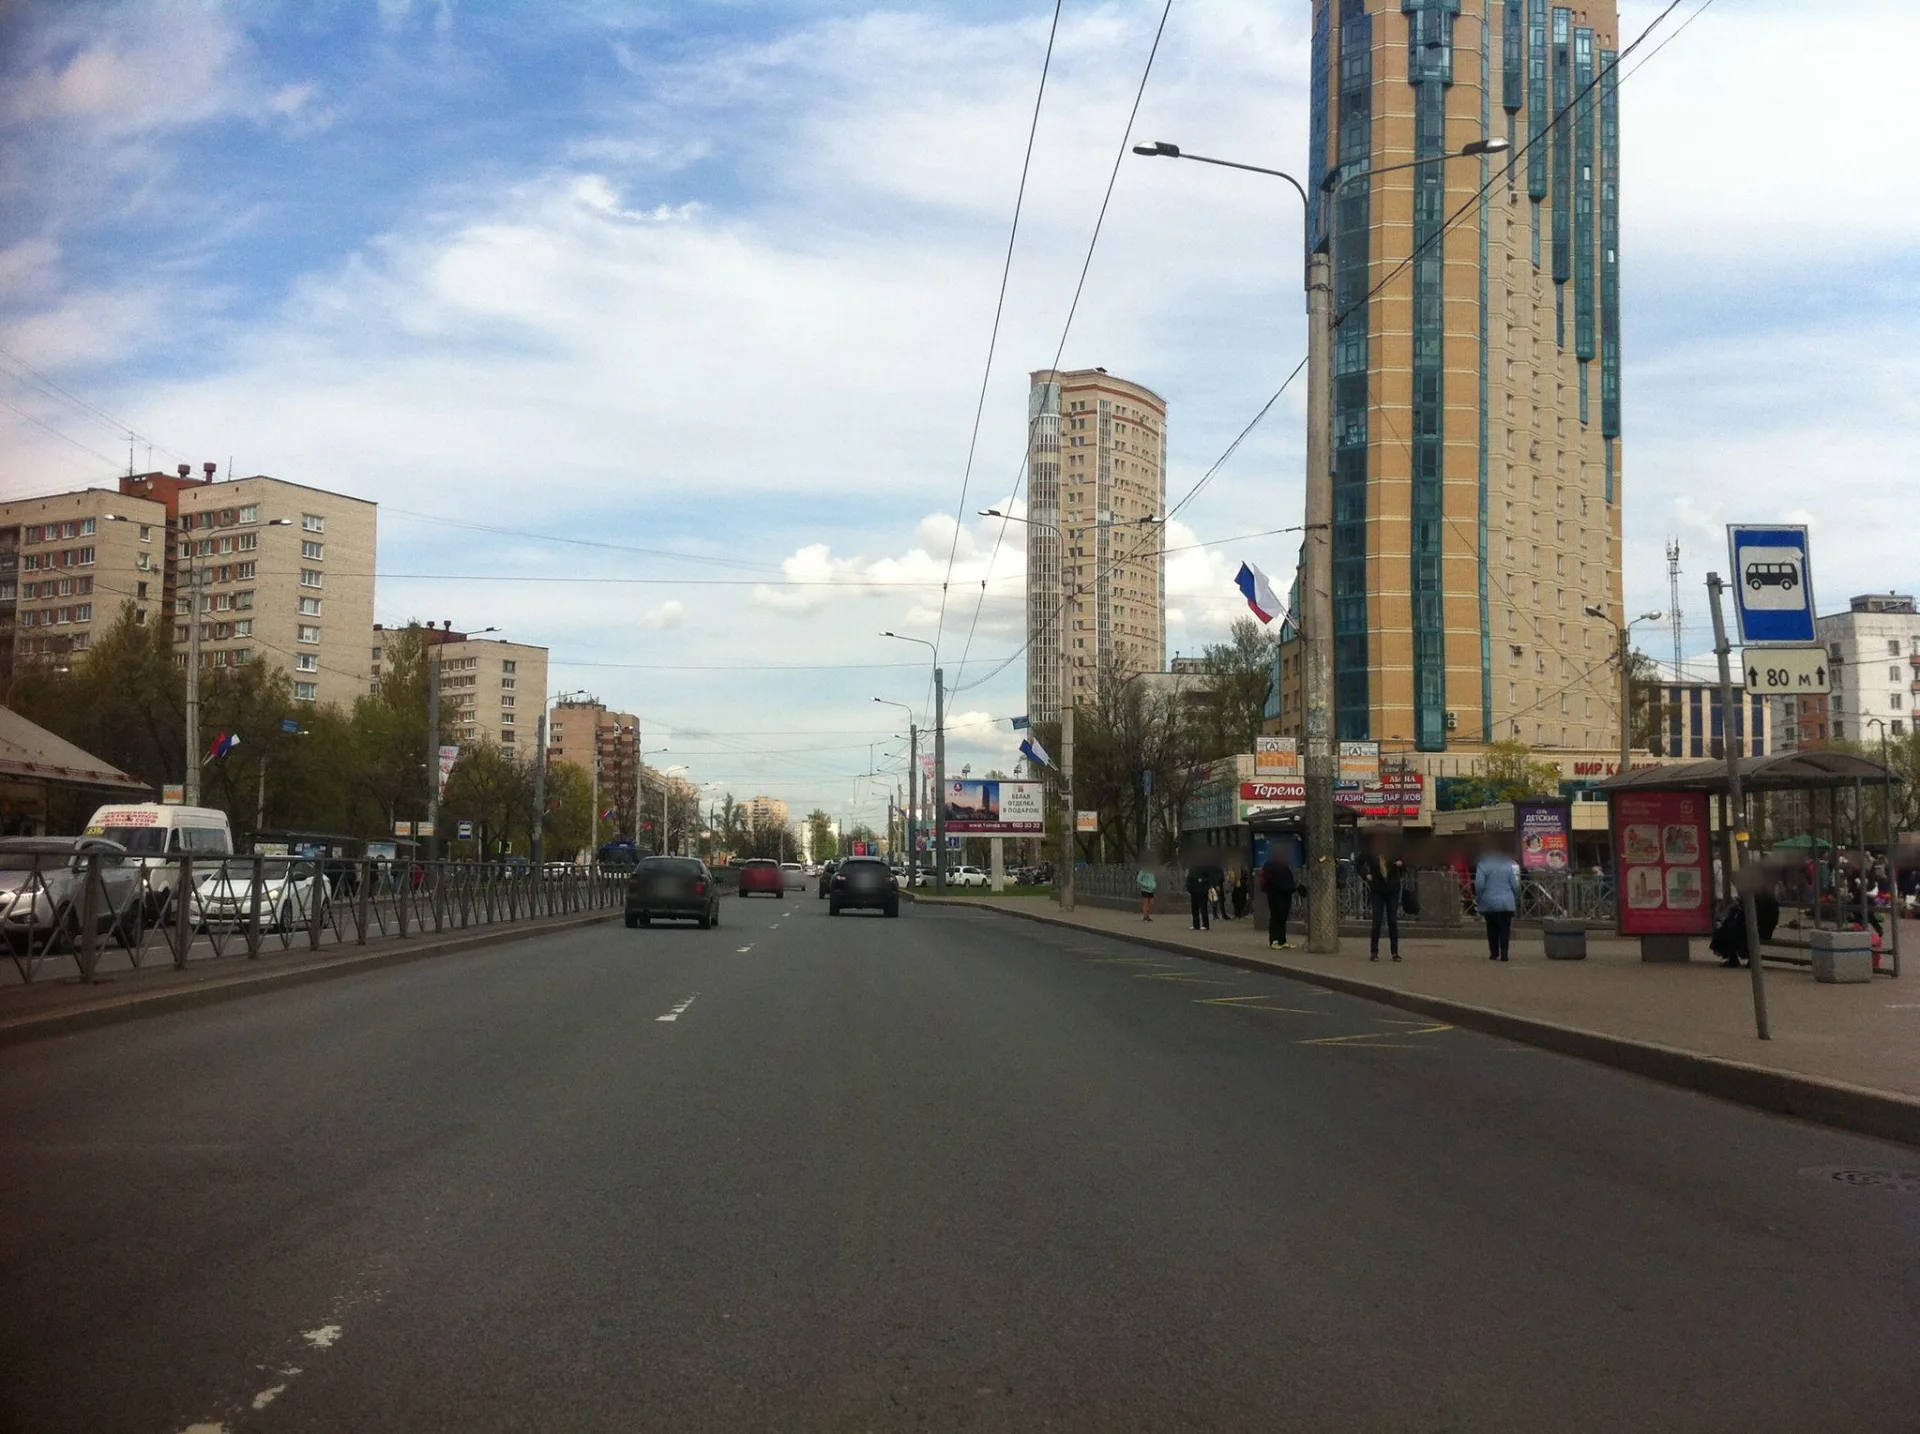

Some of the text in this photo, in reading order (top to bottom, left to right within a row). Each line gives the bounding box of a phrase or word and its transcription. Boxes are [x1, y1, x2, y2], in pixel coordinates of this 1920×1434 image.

[1767, 668, 1789, 687] 80
[1574, 762, 1603, 775] МИР
[1252, 784, 1306, 798] Теремо
[1333, 793, 1364, 802] АГАЗИН
